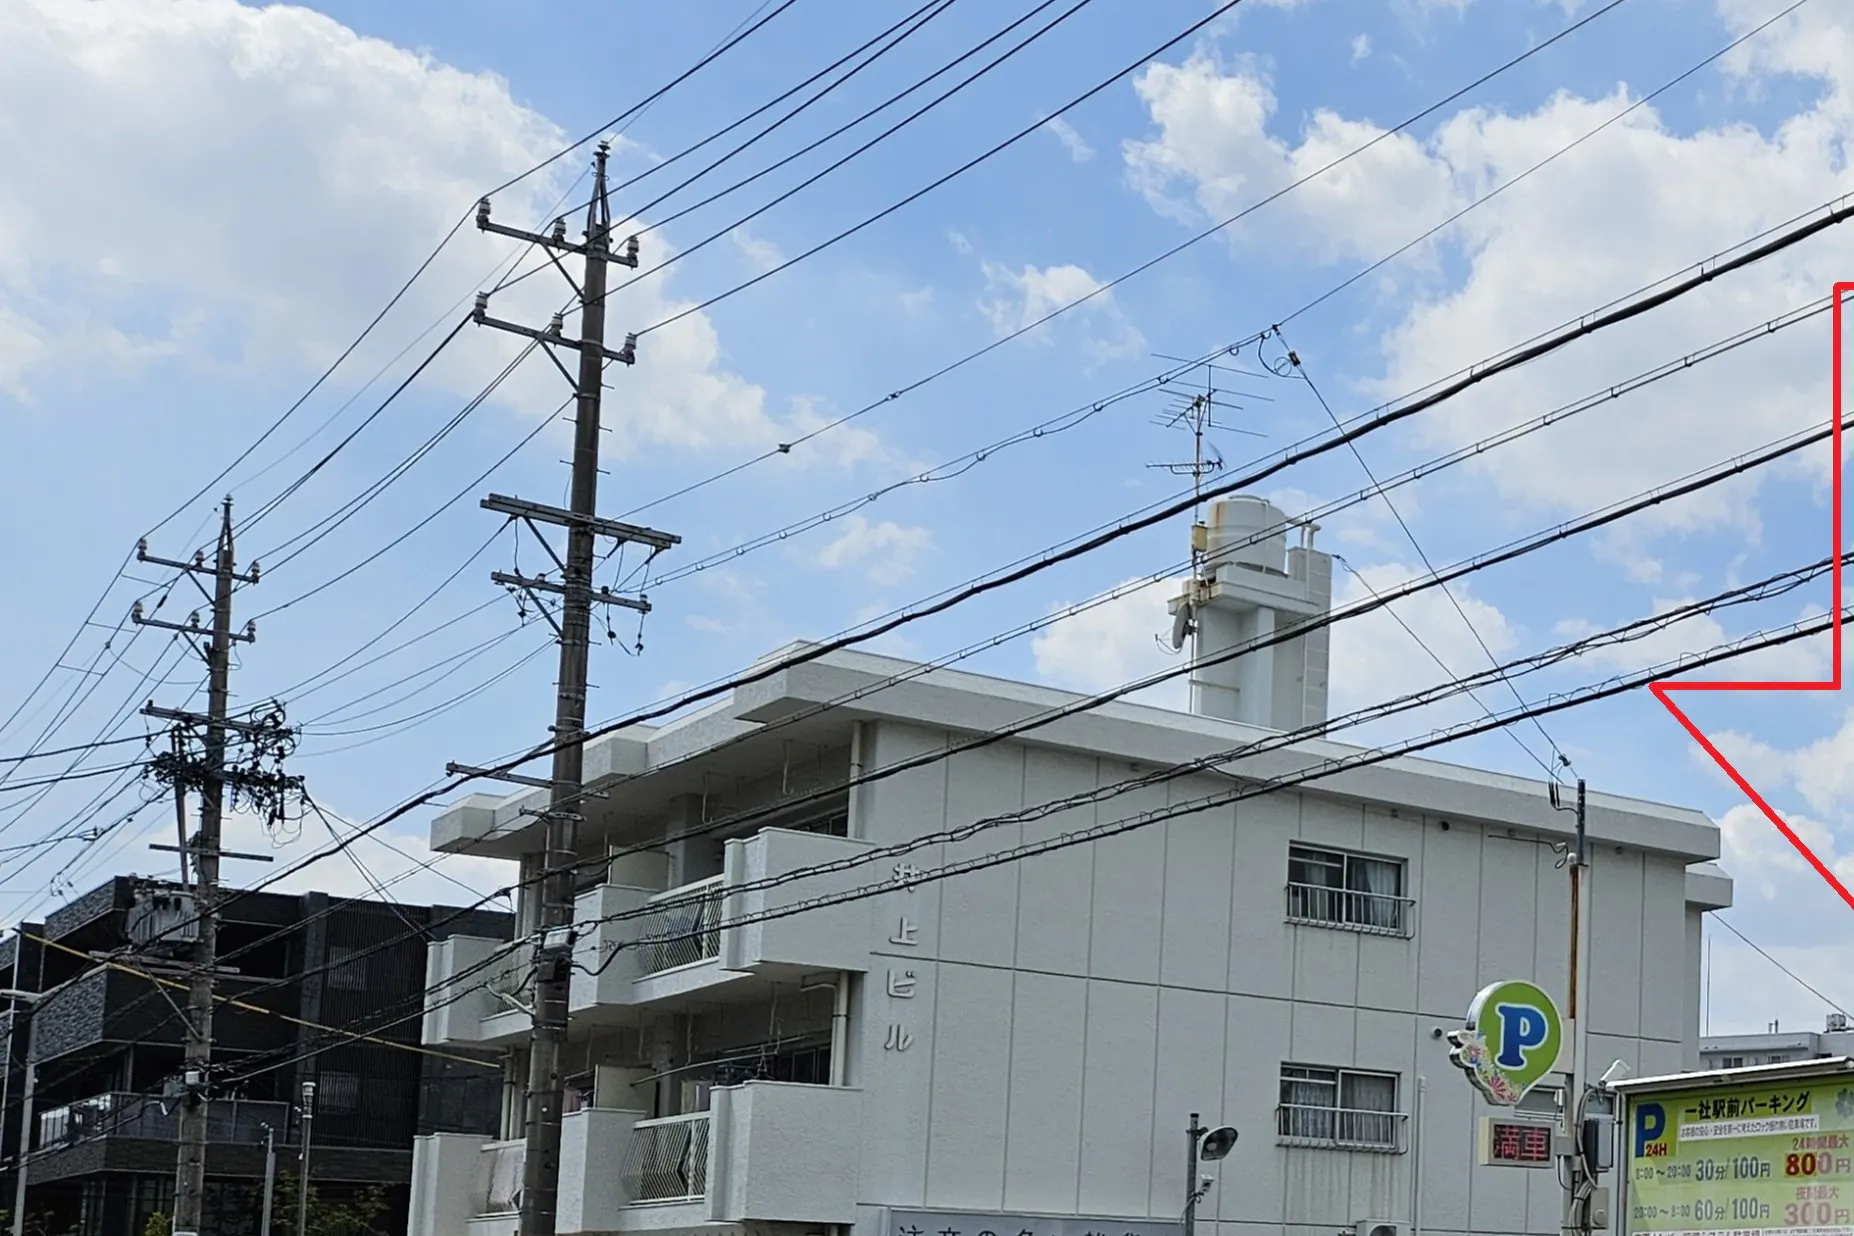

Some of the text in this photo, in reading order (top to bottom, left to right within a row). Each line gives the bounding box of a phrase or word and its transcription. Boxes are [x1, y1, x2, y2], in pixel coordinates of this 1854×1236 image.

[1496, 1003, 1547, 1069] P
[1684, 1090, 1811, 1120] 一社駅前パーキング
[1494, 1126, 1549, 1161] 満車
[1635, 1103, 1665, 1158] P
[1645, 1143, 1667, 1157] 24H
[1785, 1151, 1851, 1176] 800円
[1785, 1202, 1850, 1225] 300円
